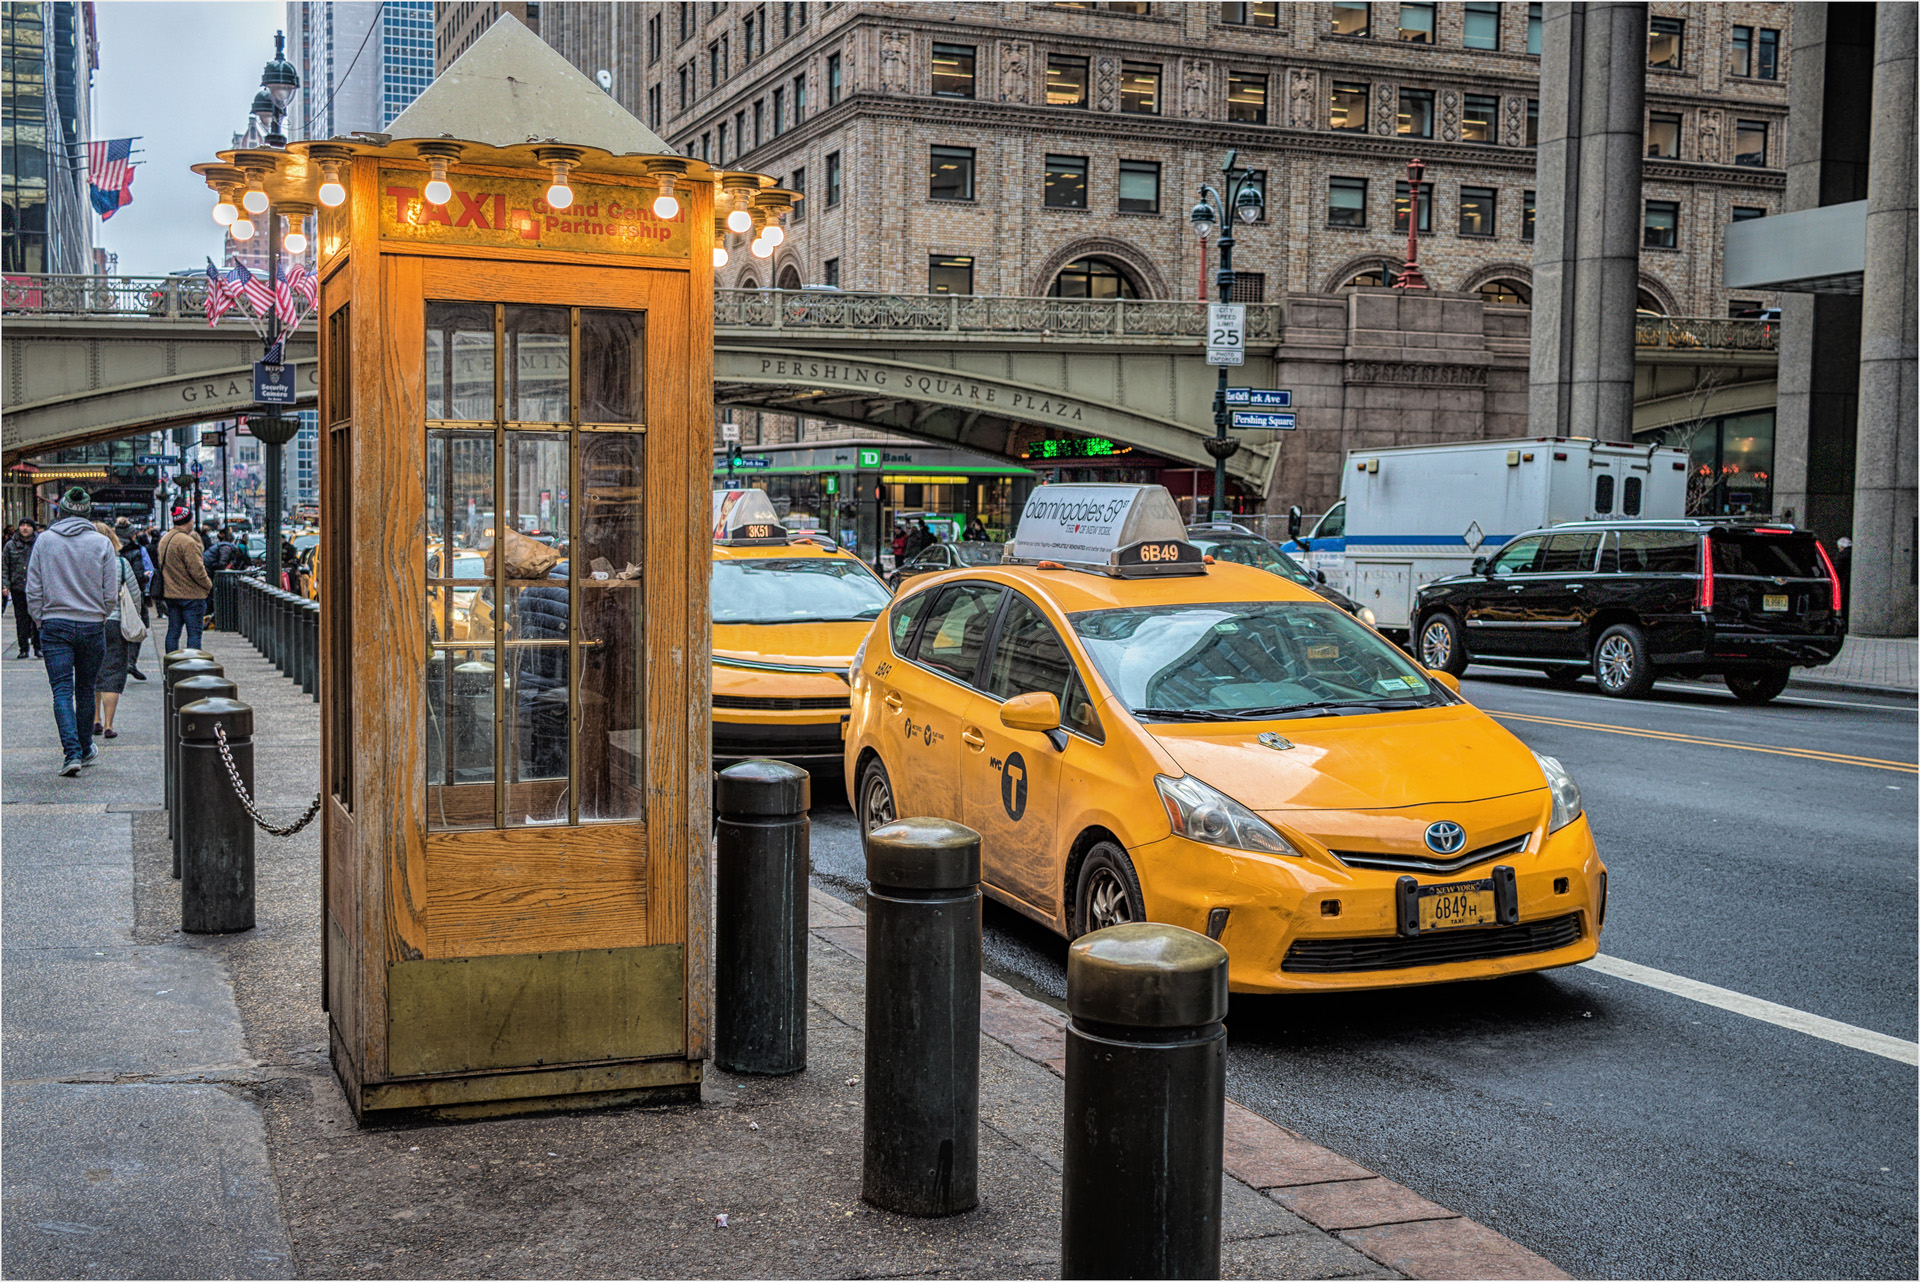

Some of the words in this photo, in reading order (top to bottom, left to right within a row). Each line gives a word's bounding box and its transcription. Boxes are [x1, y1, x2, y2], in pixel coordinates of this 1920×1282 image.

[386, 185, 506, 231] TAXI
[545, 215, 672, 242] Partnership
[1213, 329, 1239, 346] 25
[261, 384, 288, 392] Security
[762, 359, 887, 385] PERSHING
[904, 374, 996, 402] SQUARE
[1013, 394, 1083, 421] PLAZA
[1264, 394, 1281, 403] Ave
[1235, 415, 1267, 426] Pershing
[1268, 416, 1294, 427] Square
[862, 452, 879, 465] TD
[883, 453, 912, 462] Bank
[749, 525, 769, 538] 3K51
[1140, 544, 1179, 562] 6B49
[990, 756, 1003, 771] NYC
[1007, 763, 1024, 813] T
[1456, 883, 1476, 892] YORK
